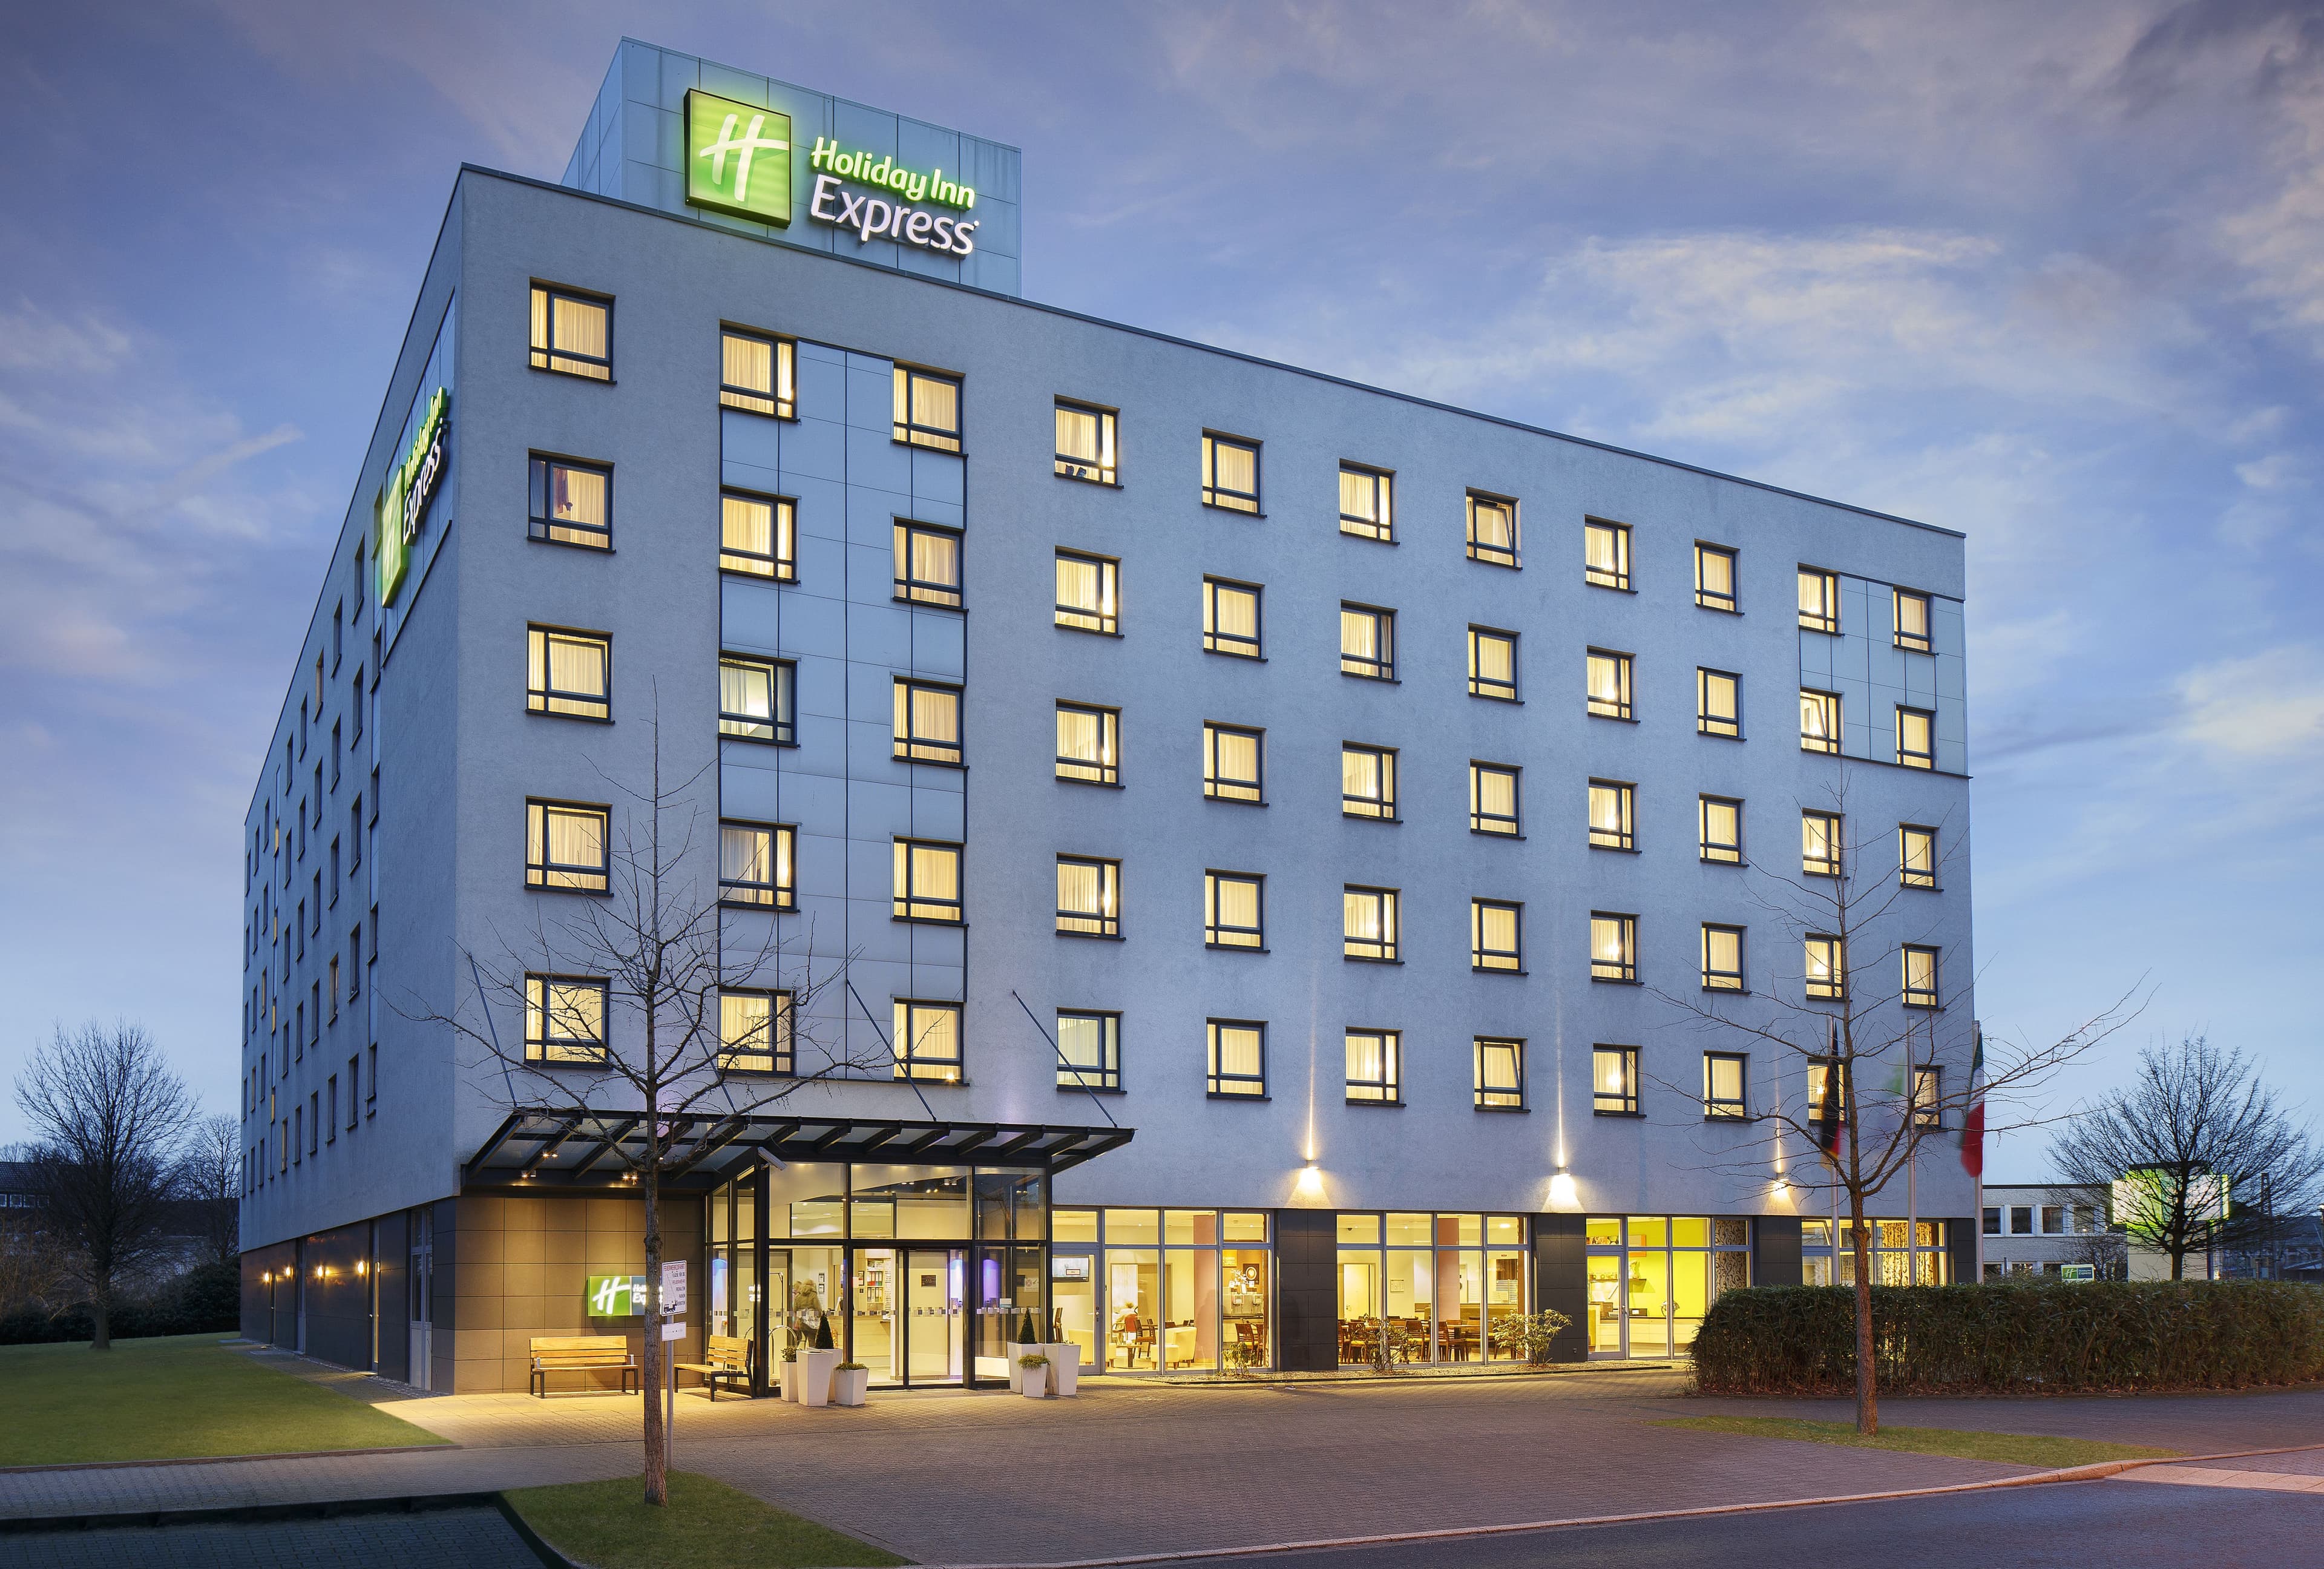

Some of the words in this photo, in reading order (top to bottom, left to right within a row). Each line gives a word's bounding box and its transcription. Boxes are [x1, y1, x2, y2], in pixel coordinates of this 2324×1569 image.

[811, 136, 927, 200] Holiday
[930, 168, 975, 208] Inn
[810, 174, 975, 256] Express
[403, 427, 442, 545] Express
